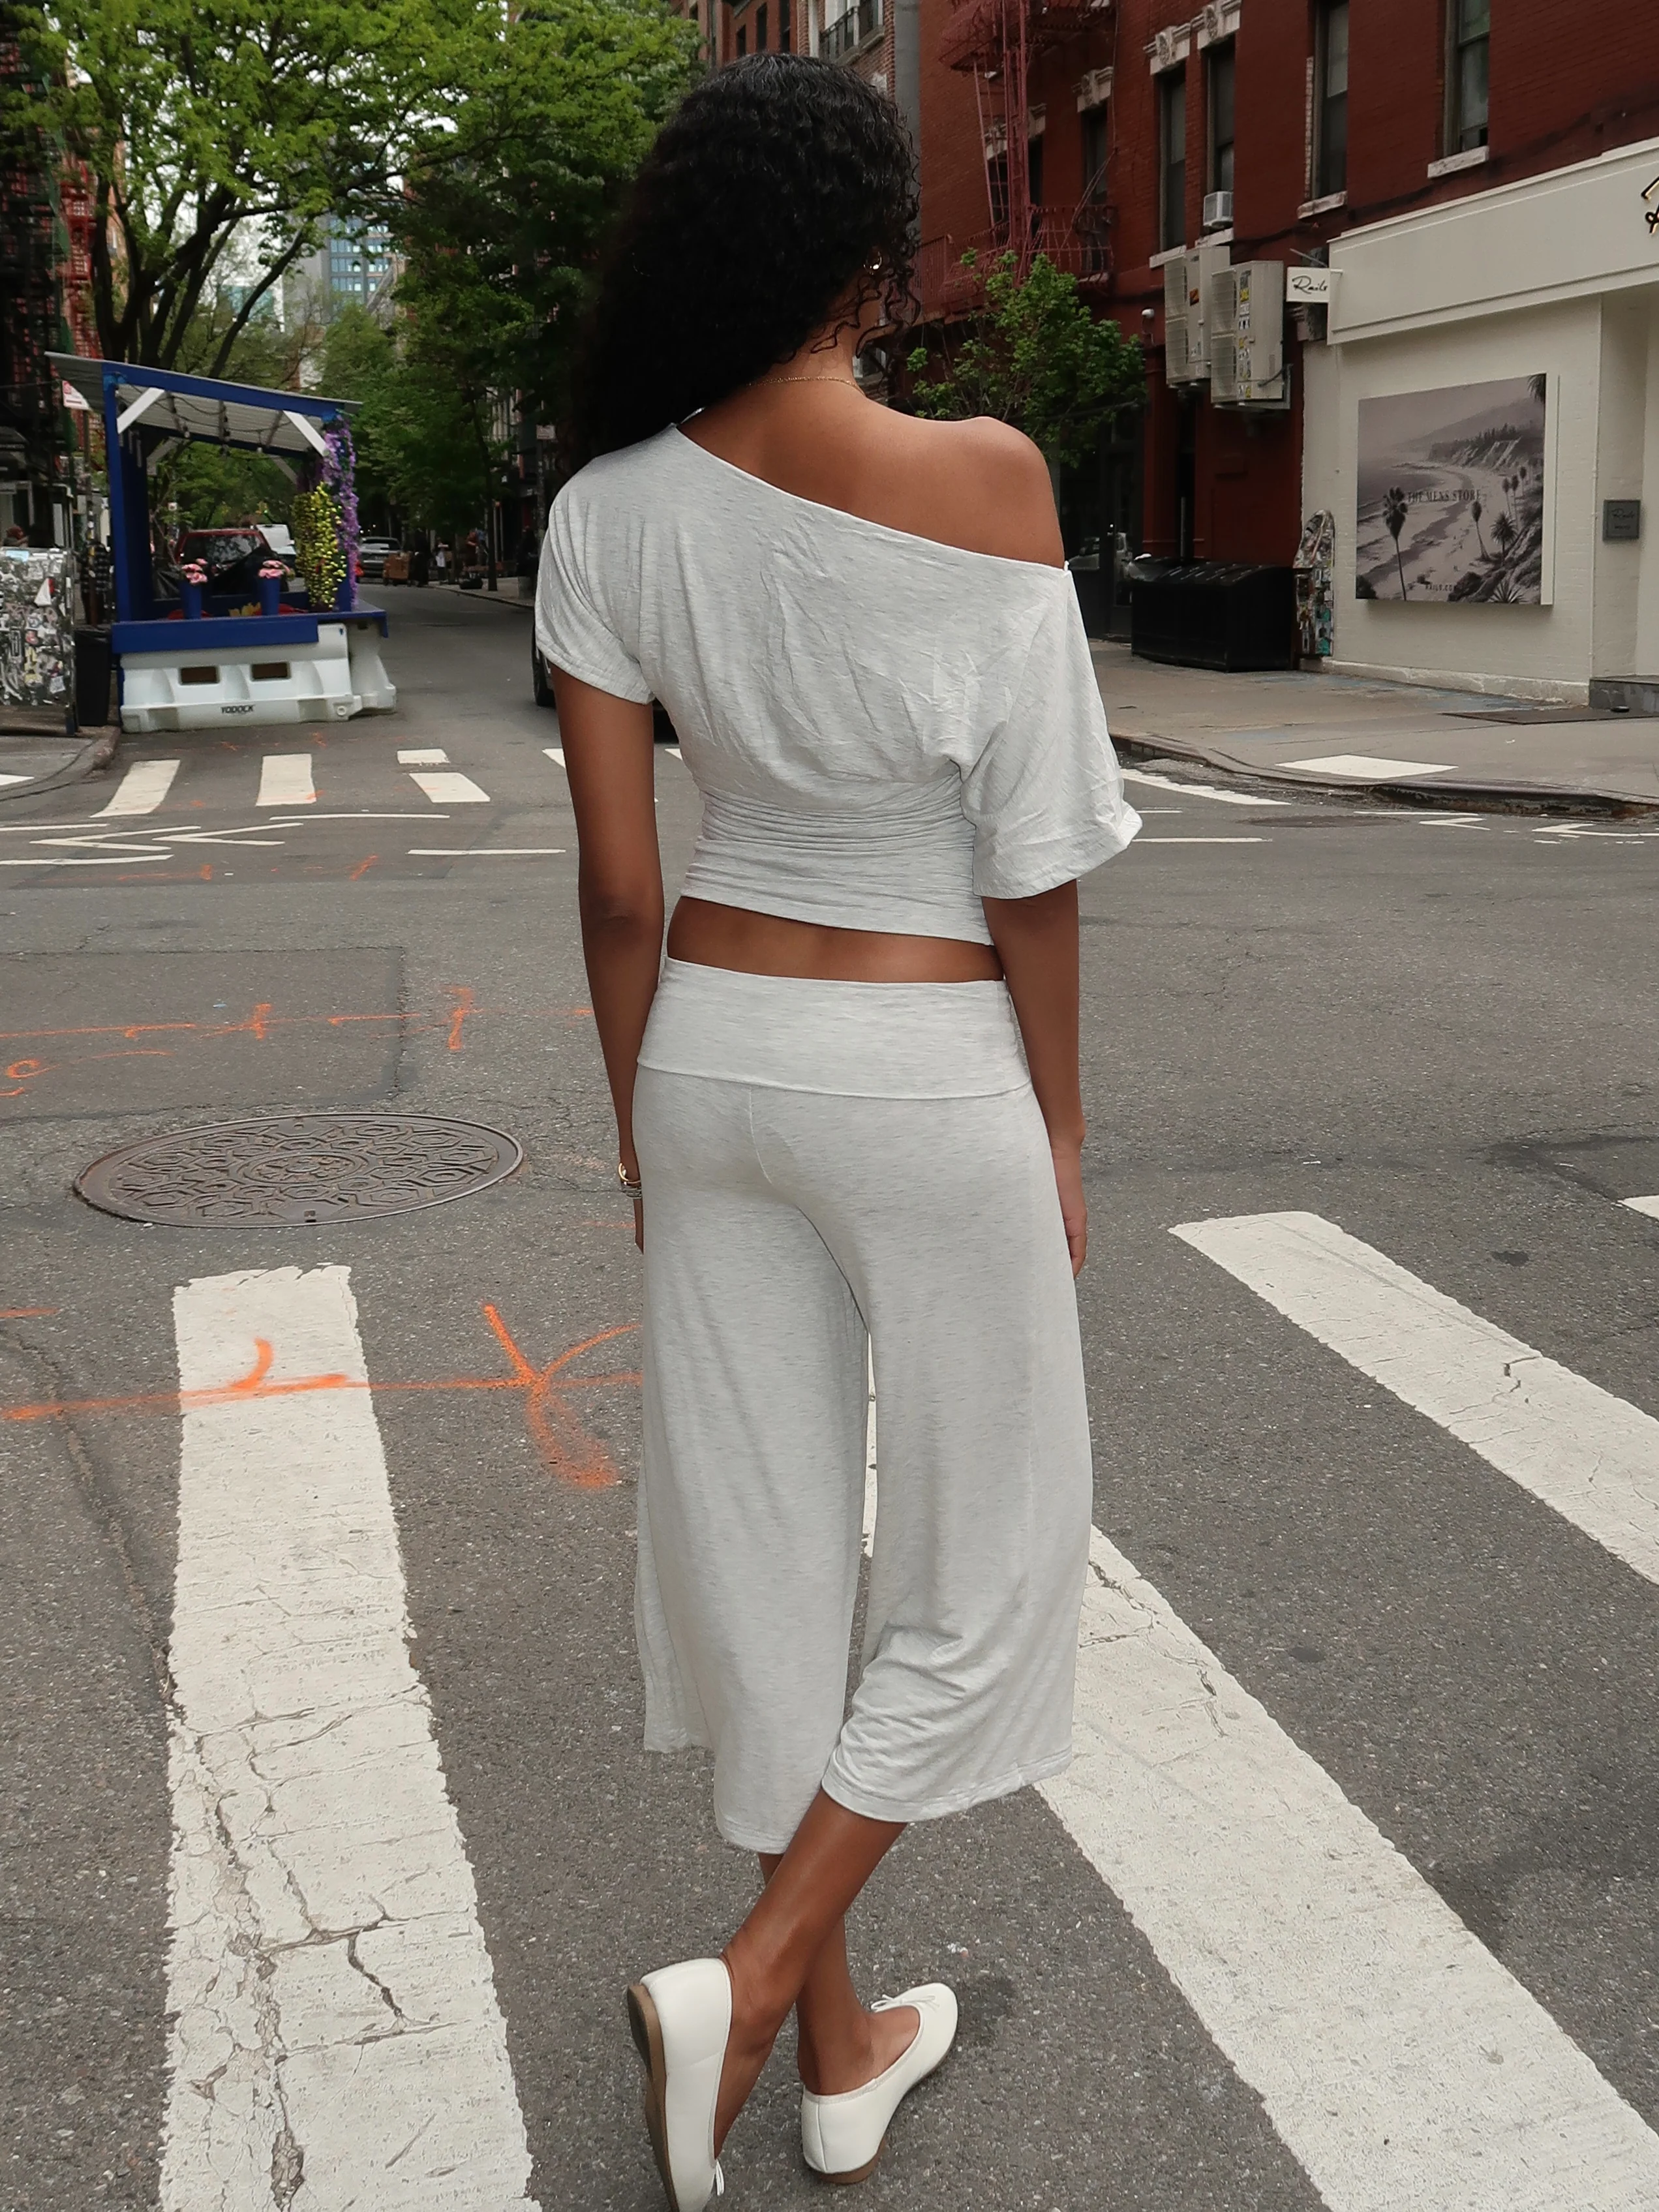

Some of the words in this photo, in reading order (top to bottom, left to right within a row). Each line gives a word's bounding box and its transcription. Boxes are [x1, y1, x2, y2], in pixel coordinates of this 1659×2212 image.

[1292, 275, 1328, 294] Rails
[1408, 491, 1423, 502] THE
[1426, 490, 1449, 502] MENS
[1452, 489, 1481, 501] STORE
[221, 705, 255, 714] YODOCK
